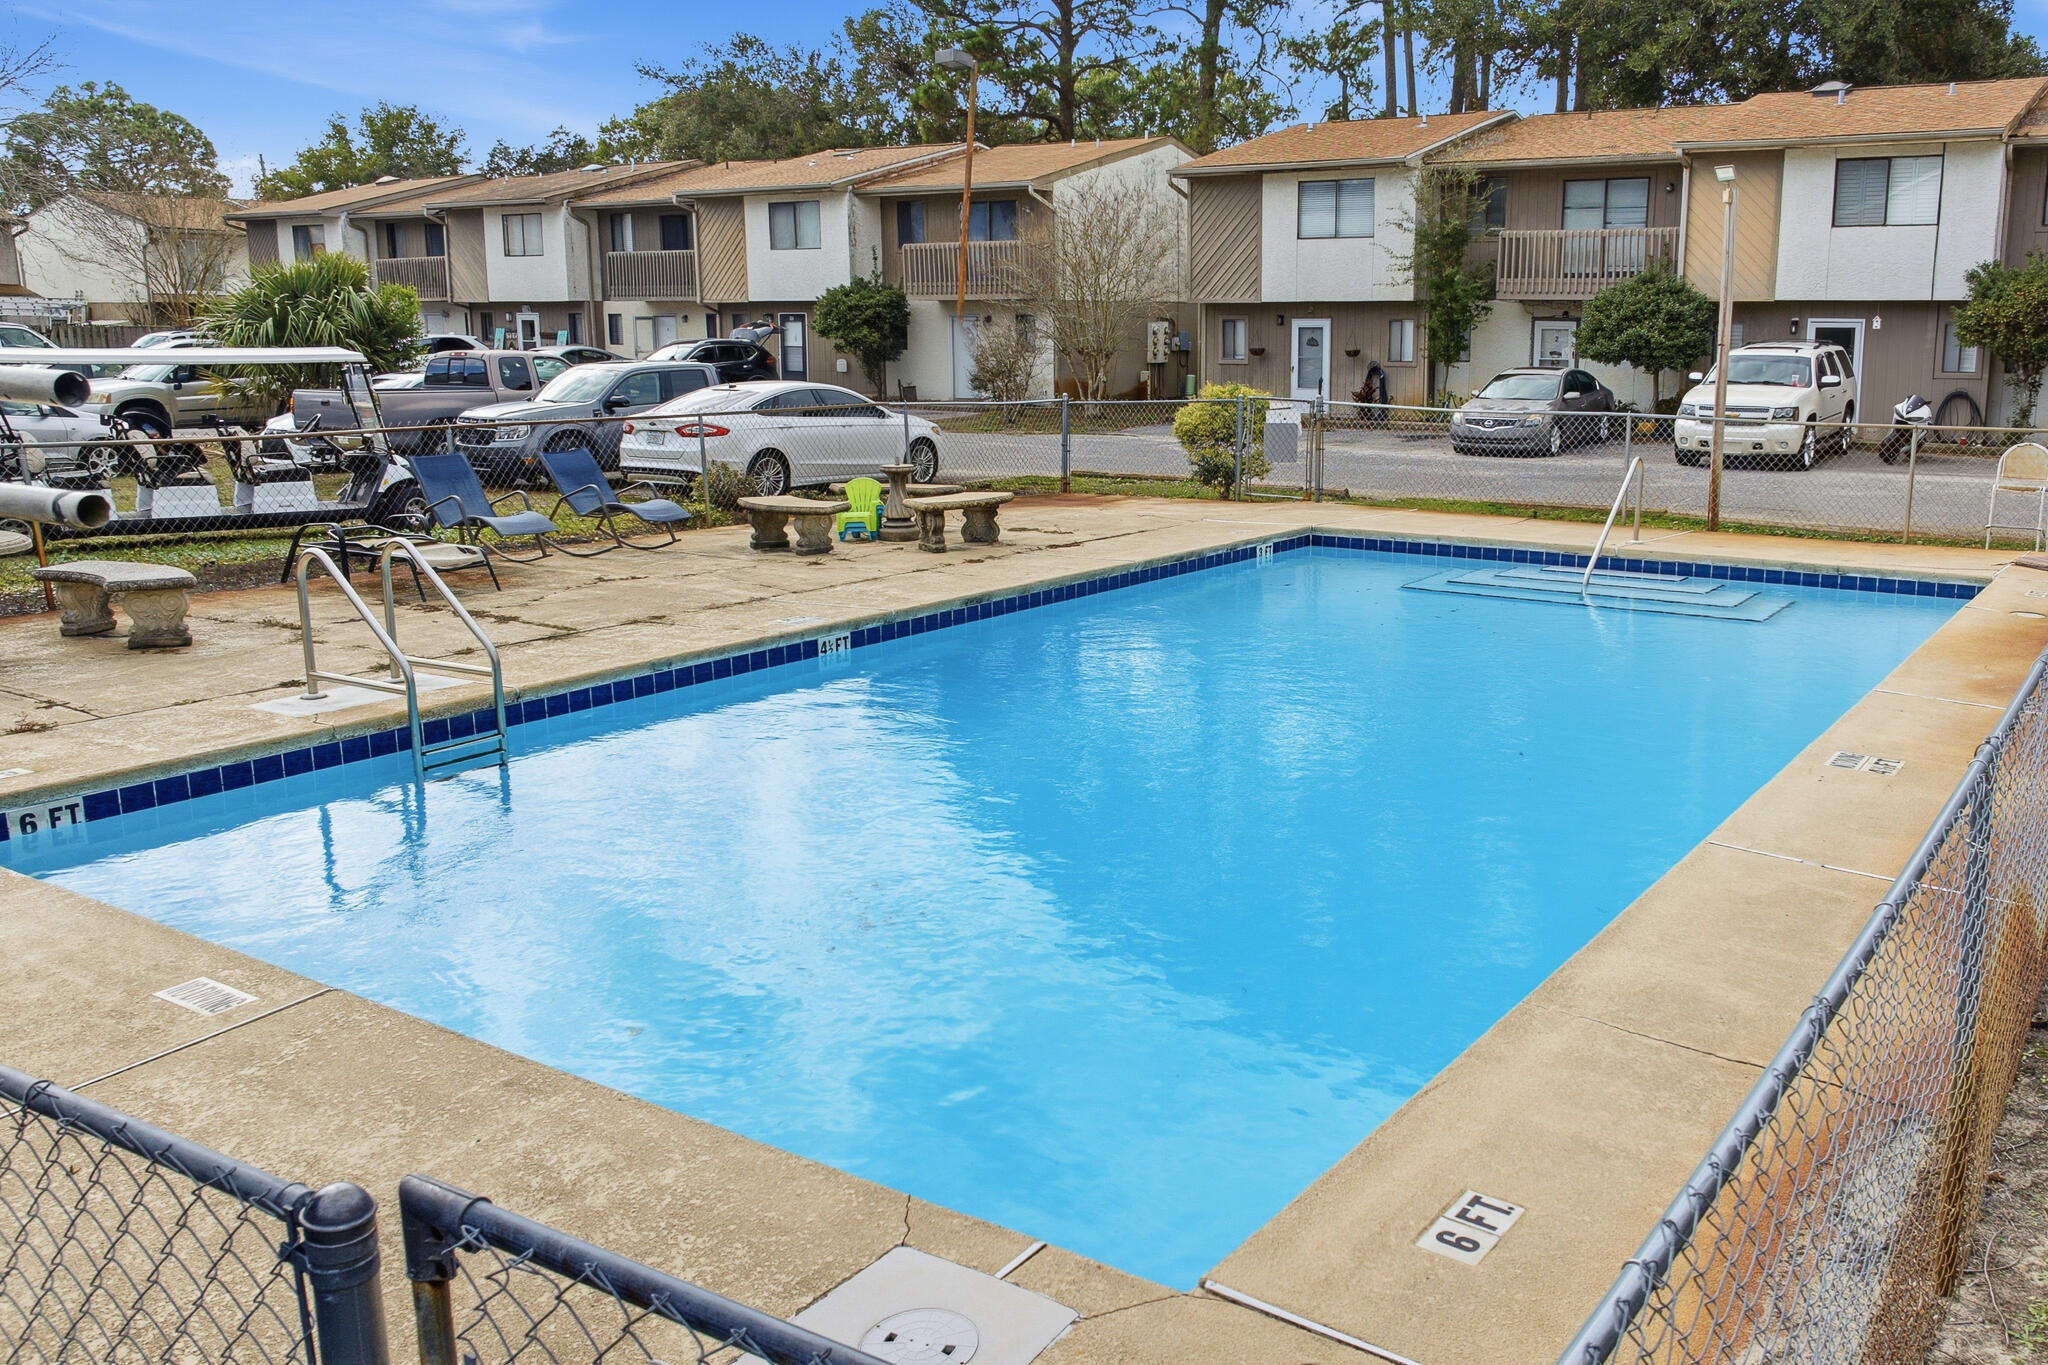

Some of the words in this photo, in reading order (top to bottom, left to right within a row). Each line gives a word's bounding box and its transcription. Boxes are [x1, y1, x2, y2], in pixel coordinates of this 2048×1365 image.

[19, 813, 38, 835] 6
[1454, 1195, 1515, 1232] FT.
[1436, 1230, 1481, 1252] 6
